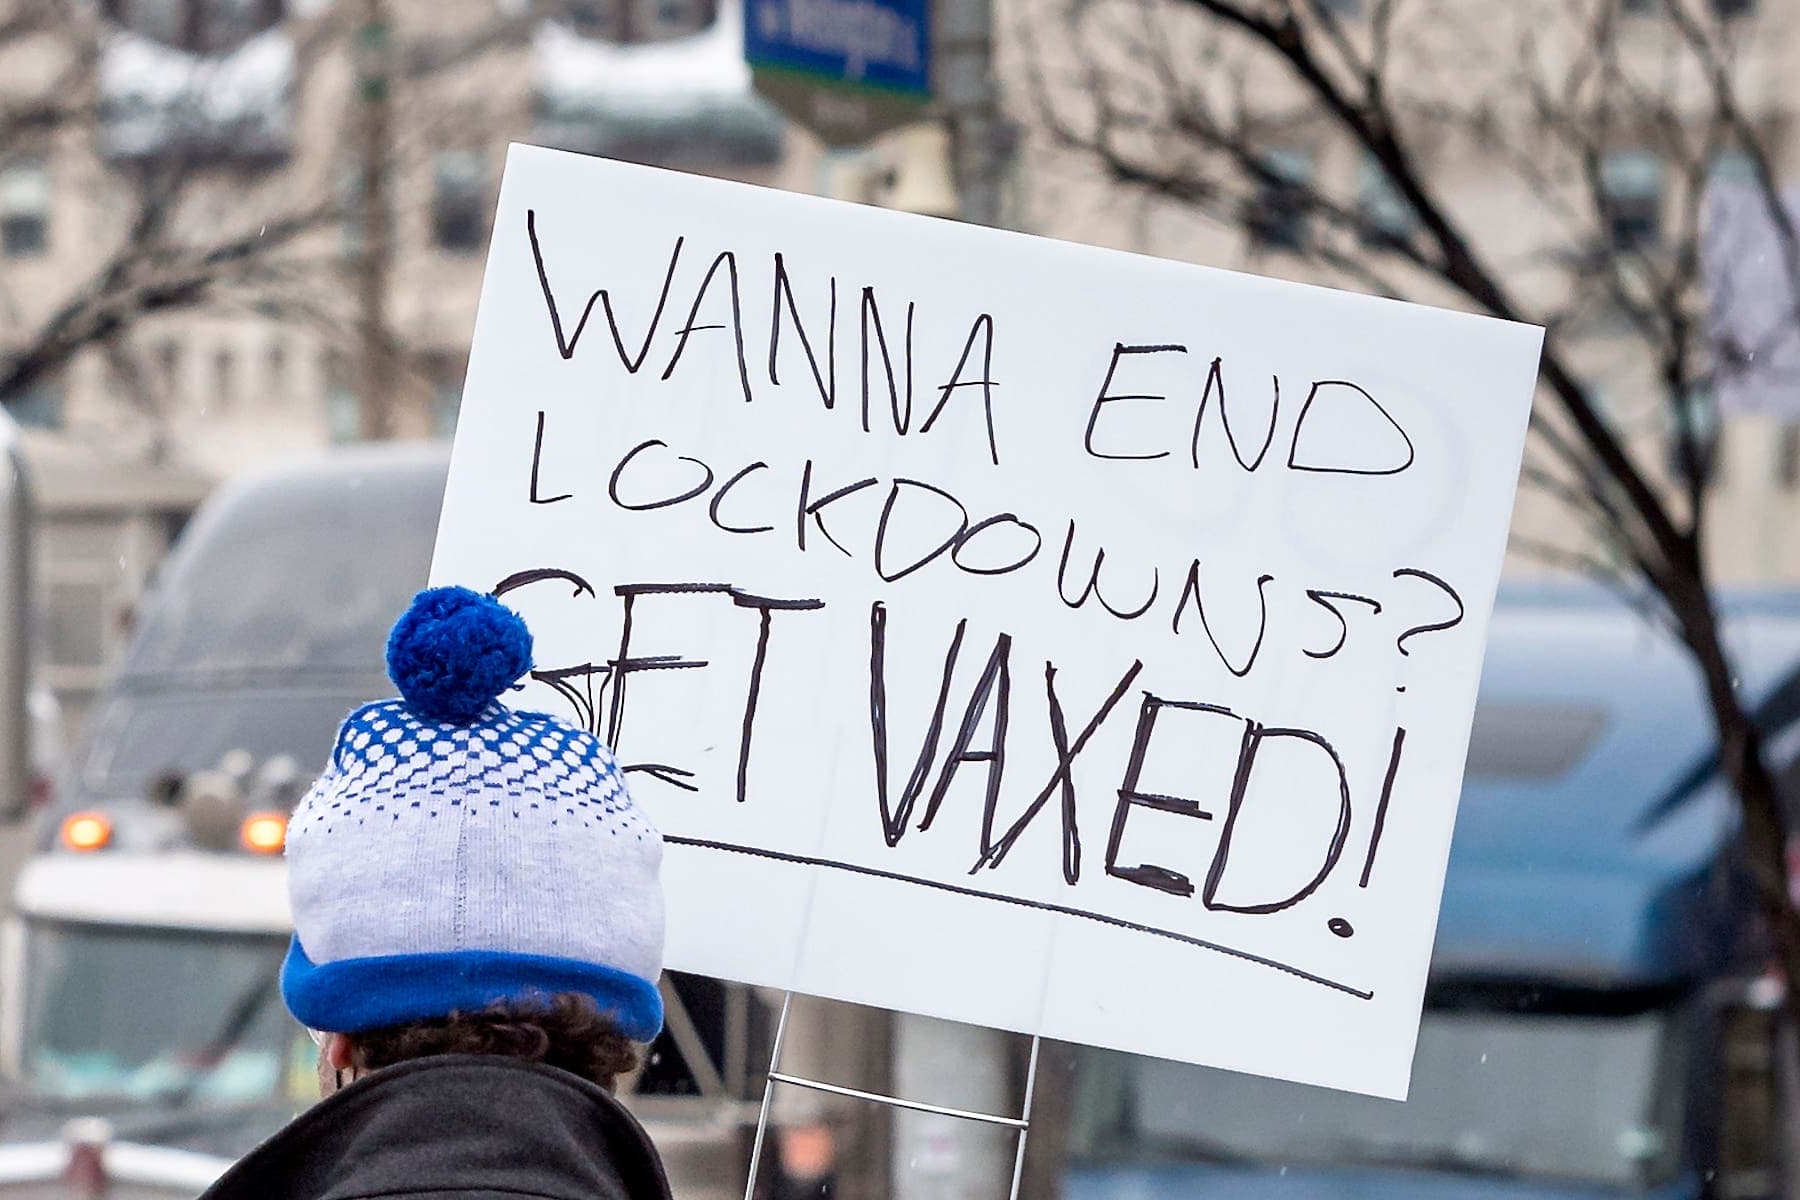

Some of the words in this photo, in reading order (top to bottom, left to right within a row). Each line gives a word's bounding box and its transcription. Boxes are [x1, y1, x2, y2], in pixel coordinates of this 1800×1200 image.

[527, 209, 1001, 466] WANNA
[1084, 341, 1415, 476] END
[529, 410, 1465, 695] LOCKDOWNS?
[870, 600, 1408, 939] VAXED!
